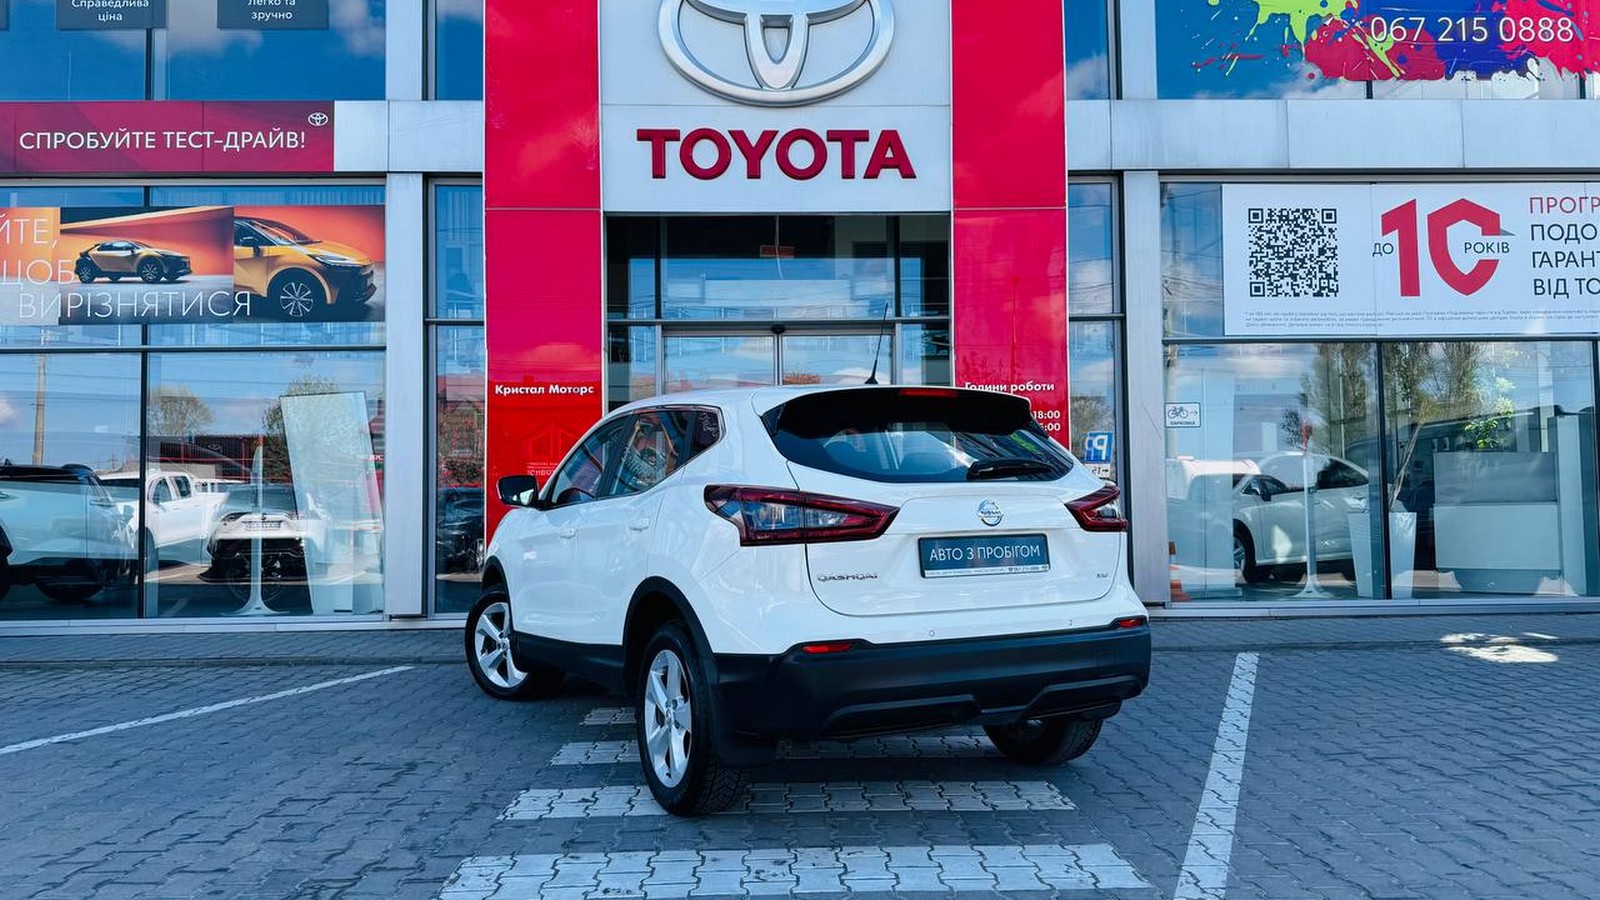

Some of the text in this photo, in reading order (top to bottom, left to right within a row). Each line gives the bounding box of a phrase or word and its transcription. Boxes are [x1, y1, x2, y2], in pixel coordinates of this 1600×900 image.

[97, 11, 124, 22] ціна
[251, 10, 293, 21] зручно
[1370, 16, 1574, 42] 067 215 0888
[19, 127, 306, 152] СПРОБУЙТЕ ТЕСТ-ДРАЙВ!
[636, 127, 917, 180] TOYOTA
[1530, 223, 1598, 245] ПОДО
[1372, 242, 1394, 257] ДО
[1464, 241, 1510, 254] РОКІВ
[1533, 278, 1600, 300] ВІД ТО
[19, 291, 251, 318] ВИРІЗНЯТИСЯ
[495, 384, 594, 396] Кристал Моторс
[1010, 381, 1055, 394] роботи
[930, 543, 1040, 561] АВТО З ПРОБІГОМ
[817, 573, 878, 582] QASHQAI
